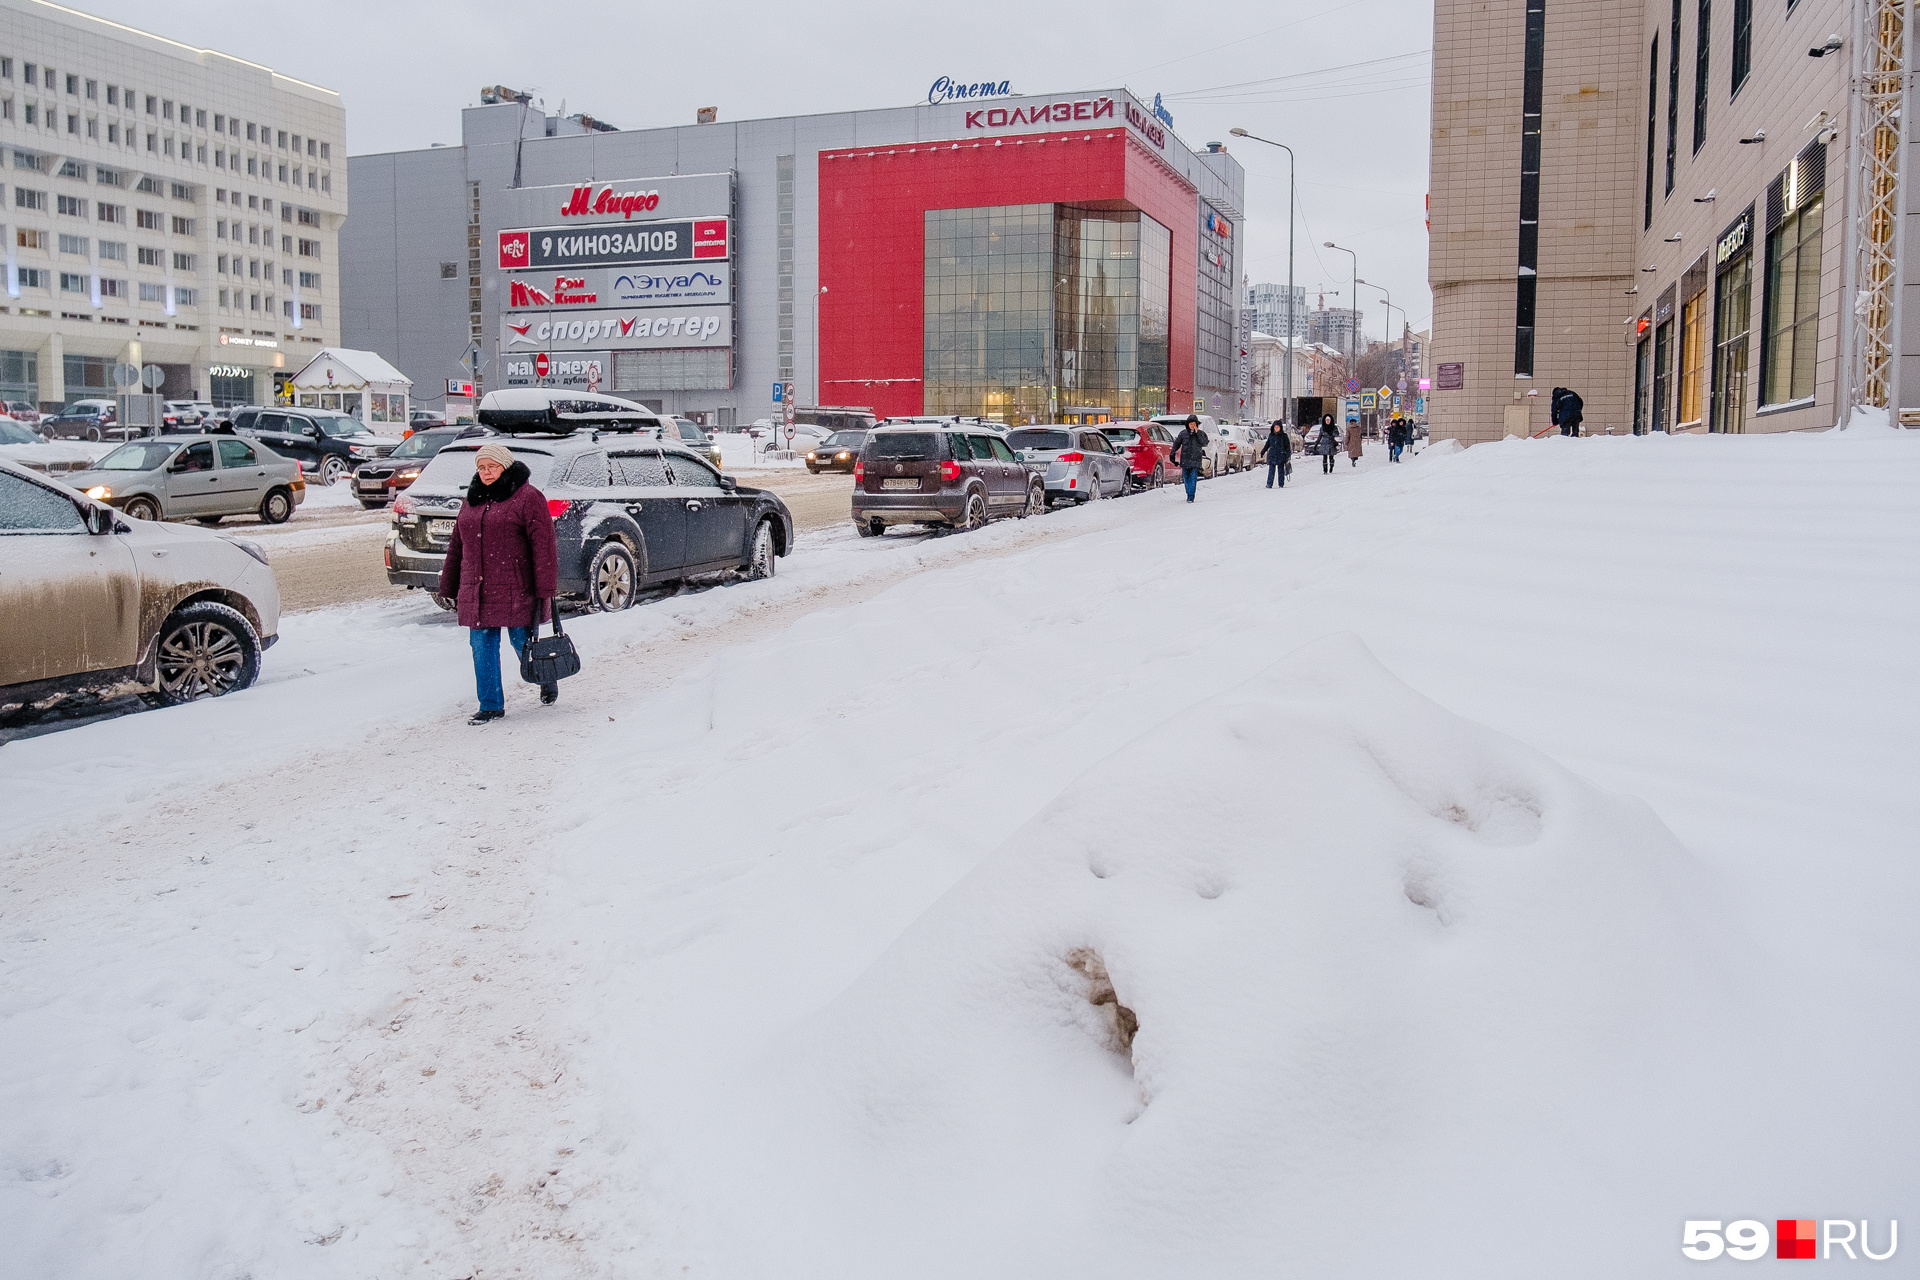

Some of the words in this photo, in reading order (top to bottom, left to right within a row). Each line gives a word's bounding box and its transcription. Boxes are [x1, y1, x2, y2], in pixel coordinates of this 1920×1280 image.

[928, 75, 1010, 106] Cinema
[965, 96, 1114, 129] КОЛИЗЕЙ
[1125, 102, 1166, 149] КОЛИЗЕЙ
[541, 237, 552, 257] 9
[557, 231, 678, 257] КИНОЗАЛОВ
[554, 292, 597, 305] Книги
[774, 386, 781, 399] P
